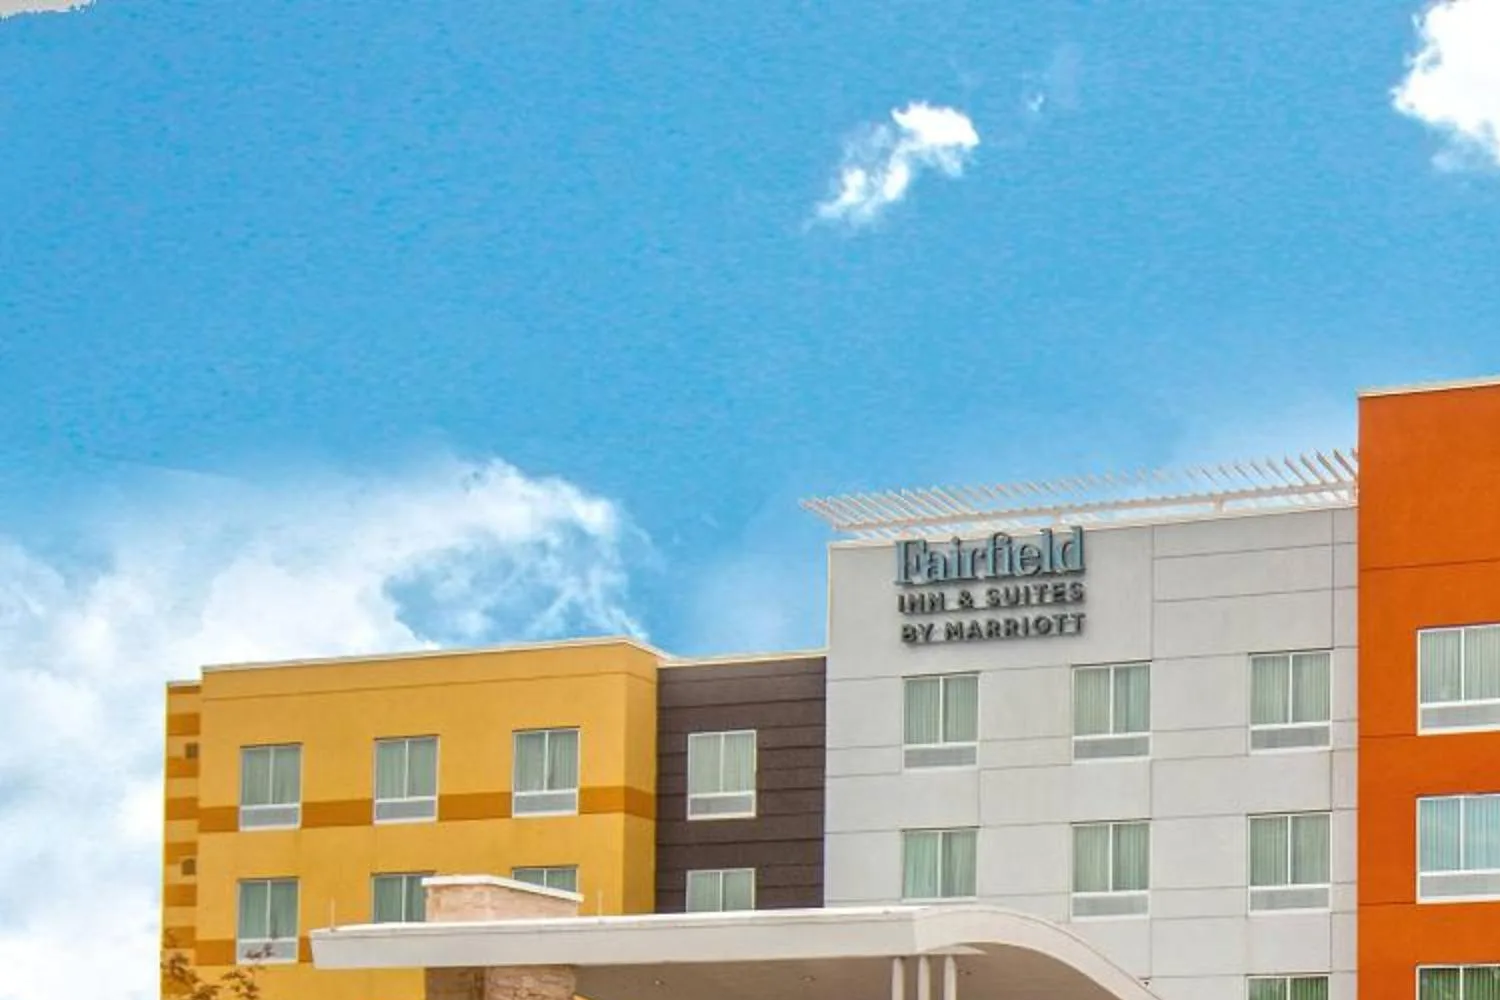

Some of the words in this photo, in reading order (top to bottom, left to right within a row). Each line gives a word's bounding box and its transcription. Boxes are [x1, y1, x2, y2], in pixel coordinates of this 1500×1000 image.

[895, 525, 1085, 584] Fairfield
[897, 592, 945, 613] INN
[957, 589, 974, 609] &
[986, 582, 1086, 607] SUITES
[901, 622, 934, 643] BY
[945, 612, 1086, 641] MARRIOTT
